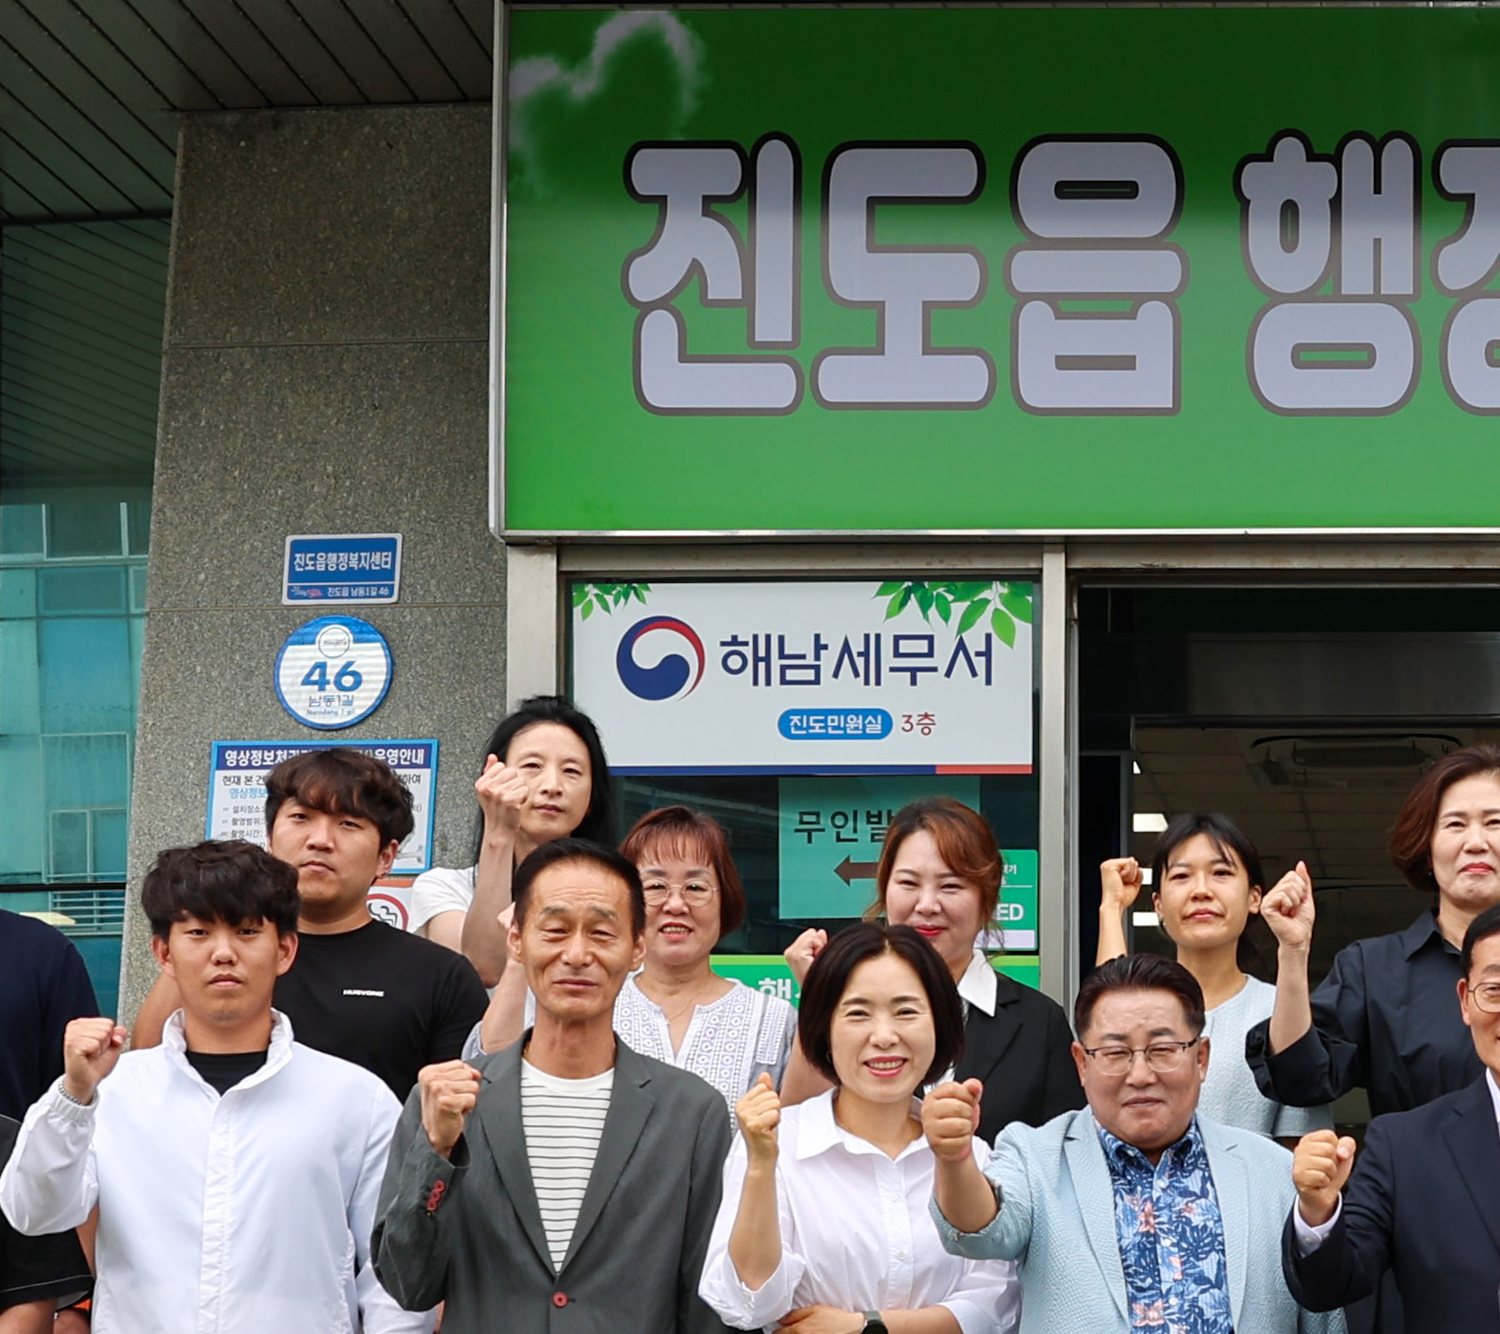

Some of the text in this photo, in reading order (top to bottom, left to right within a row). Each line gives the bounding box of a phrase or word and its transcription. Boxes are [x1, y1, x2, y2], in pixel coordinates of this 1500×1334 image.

[620, 133, 1194, 418] 진도읍
[293, 551, 392, 572] 진도읍행정복지센터
[719, 632, 993, 687] 해남세무서
[300, 660, 363, 692] 46
[308, 694, 354, 708] 남동1길
[789, 712, 937, 736] 진도민원실 3층
